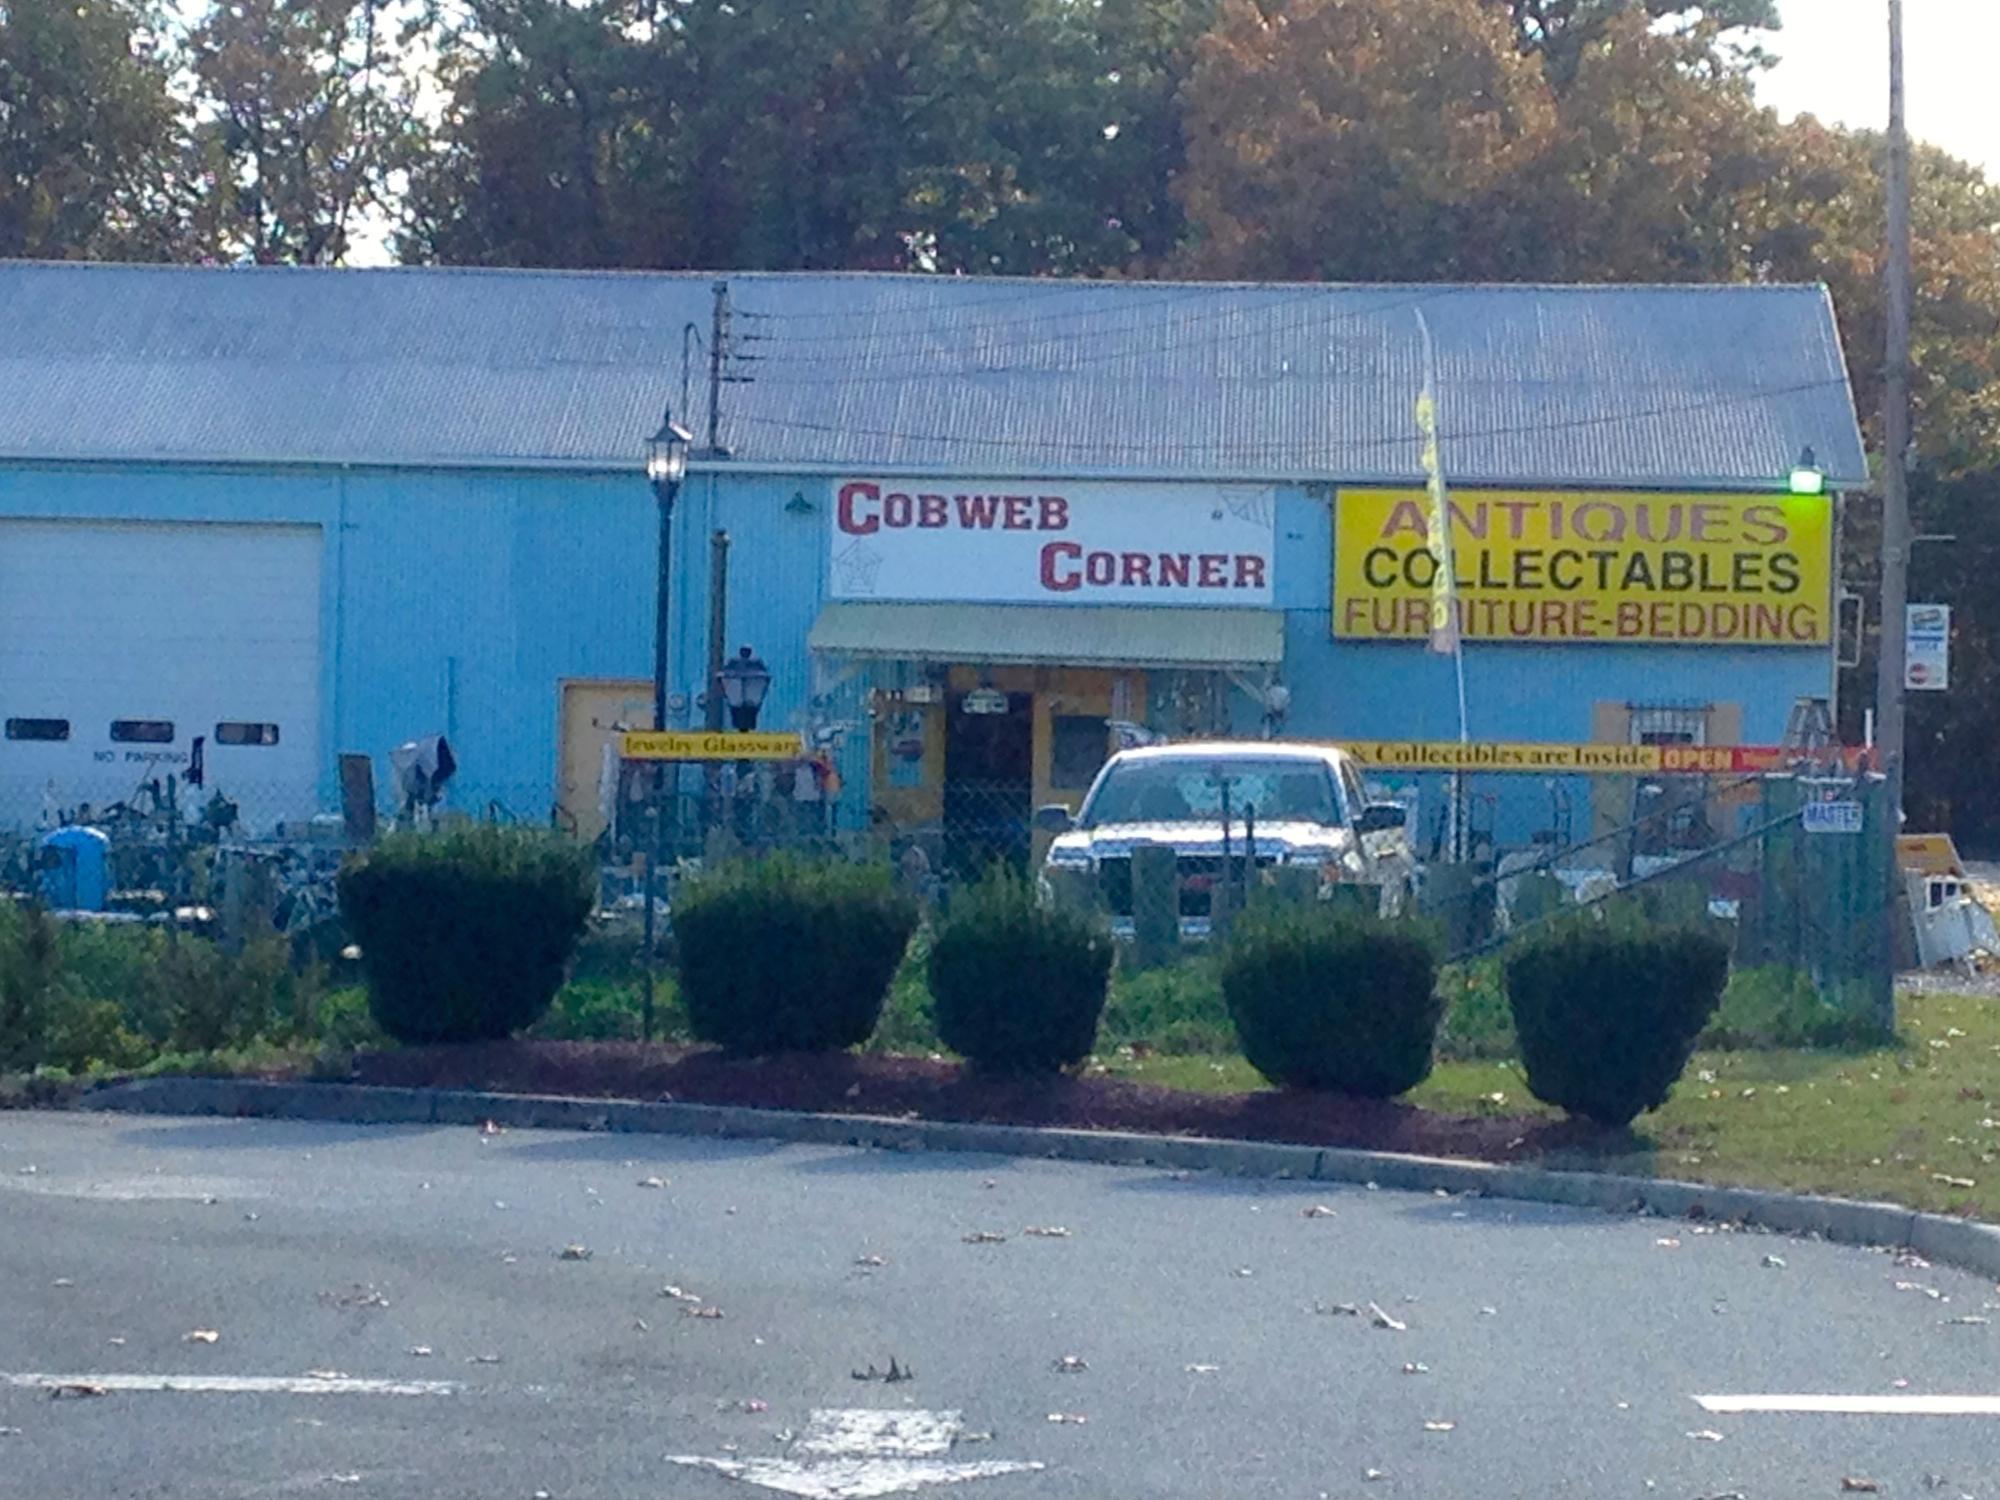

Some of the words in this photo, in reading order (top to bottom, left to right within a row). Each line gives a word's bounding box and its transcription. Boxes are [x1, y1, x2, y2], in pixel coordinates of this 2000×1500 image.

[838, 482, 1070, 535] COBWEB
[1380, 500, 1789, 545] ANTIQUES
[1040, 541, 1266, 593] CORNER
[1362, 547, 1801, 594] COLLECTABLES
[1344, 597, 1818, 640] FURITURE-BEDDING
[93, 750, 115, 763] NO
[124, 750, 188, 763] PARKING
[1376, 745, 1523, 765] Collectibles
[1529, 751, 1569, 765] are
[1575, 746, 1652, 766] Inside
[1664, 749, 1733, 769] OPEN
